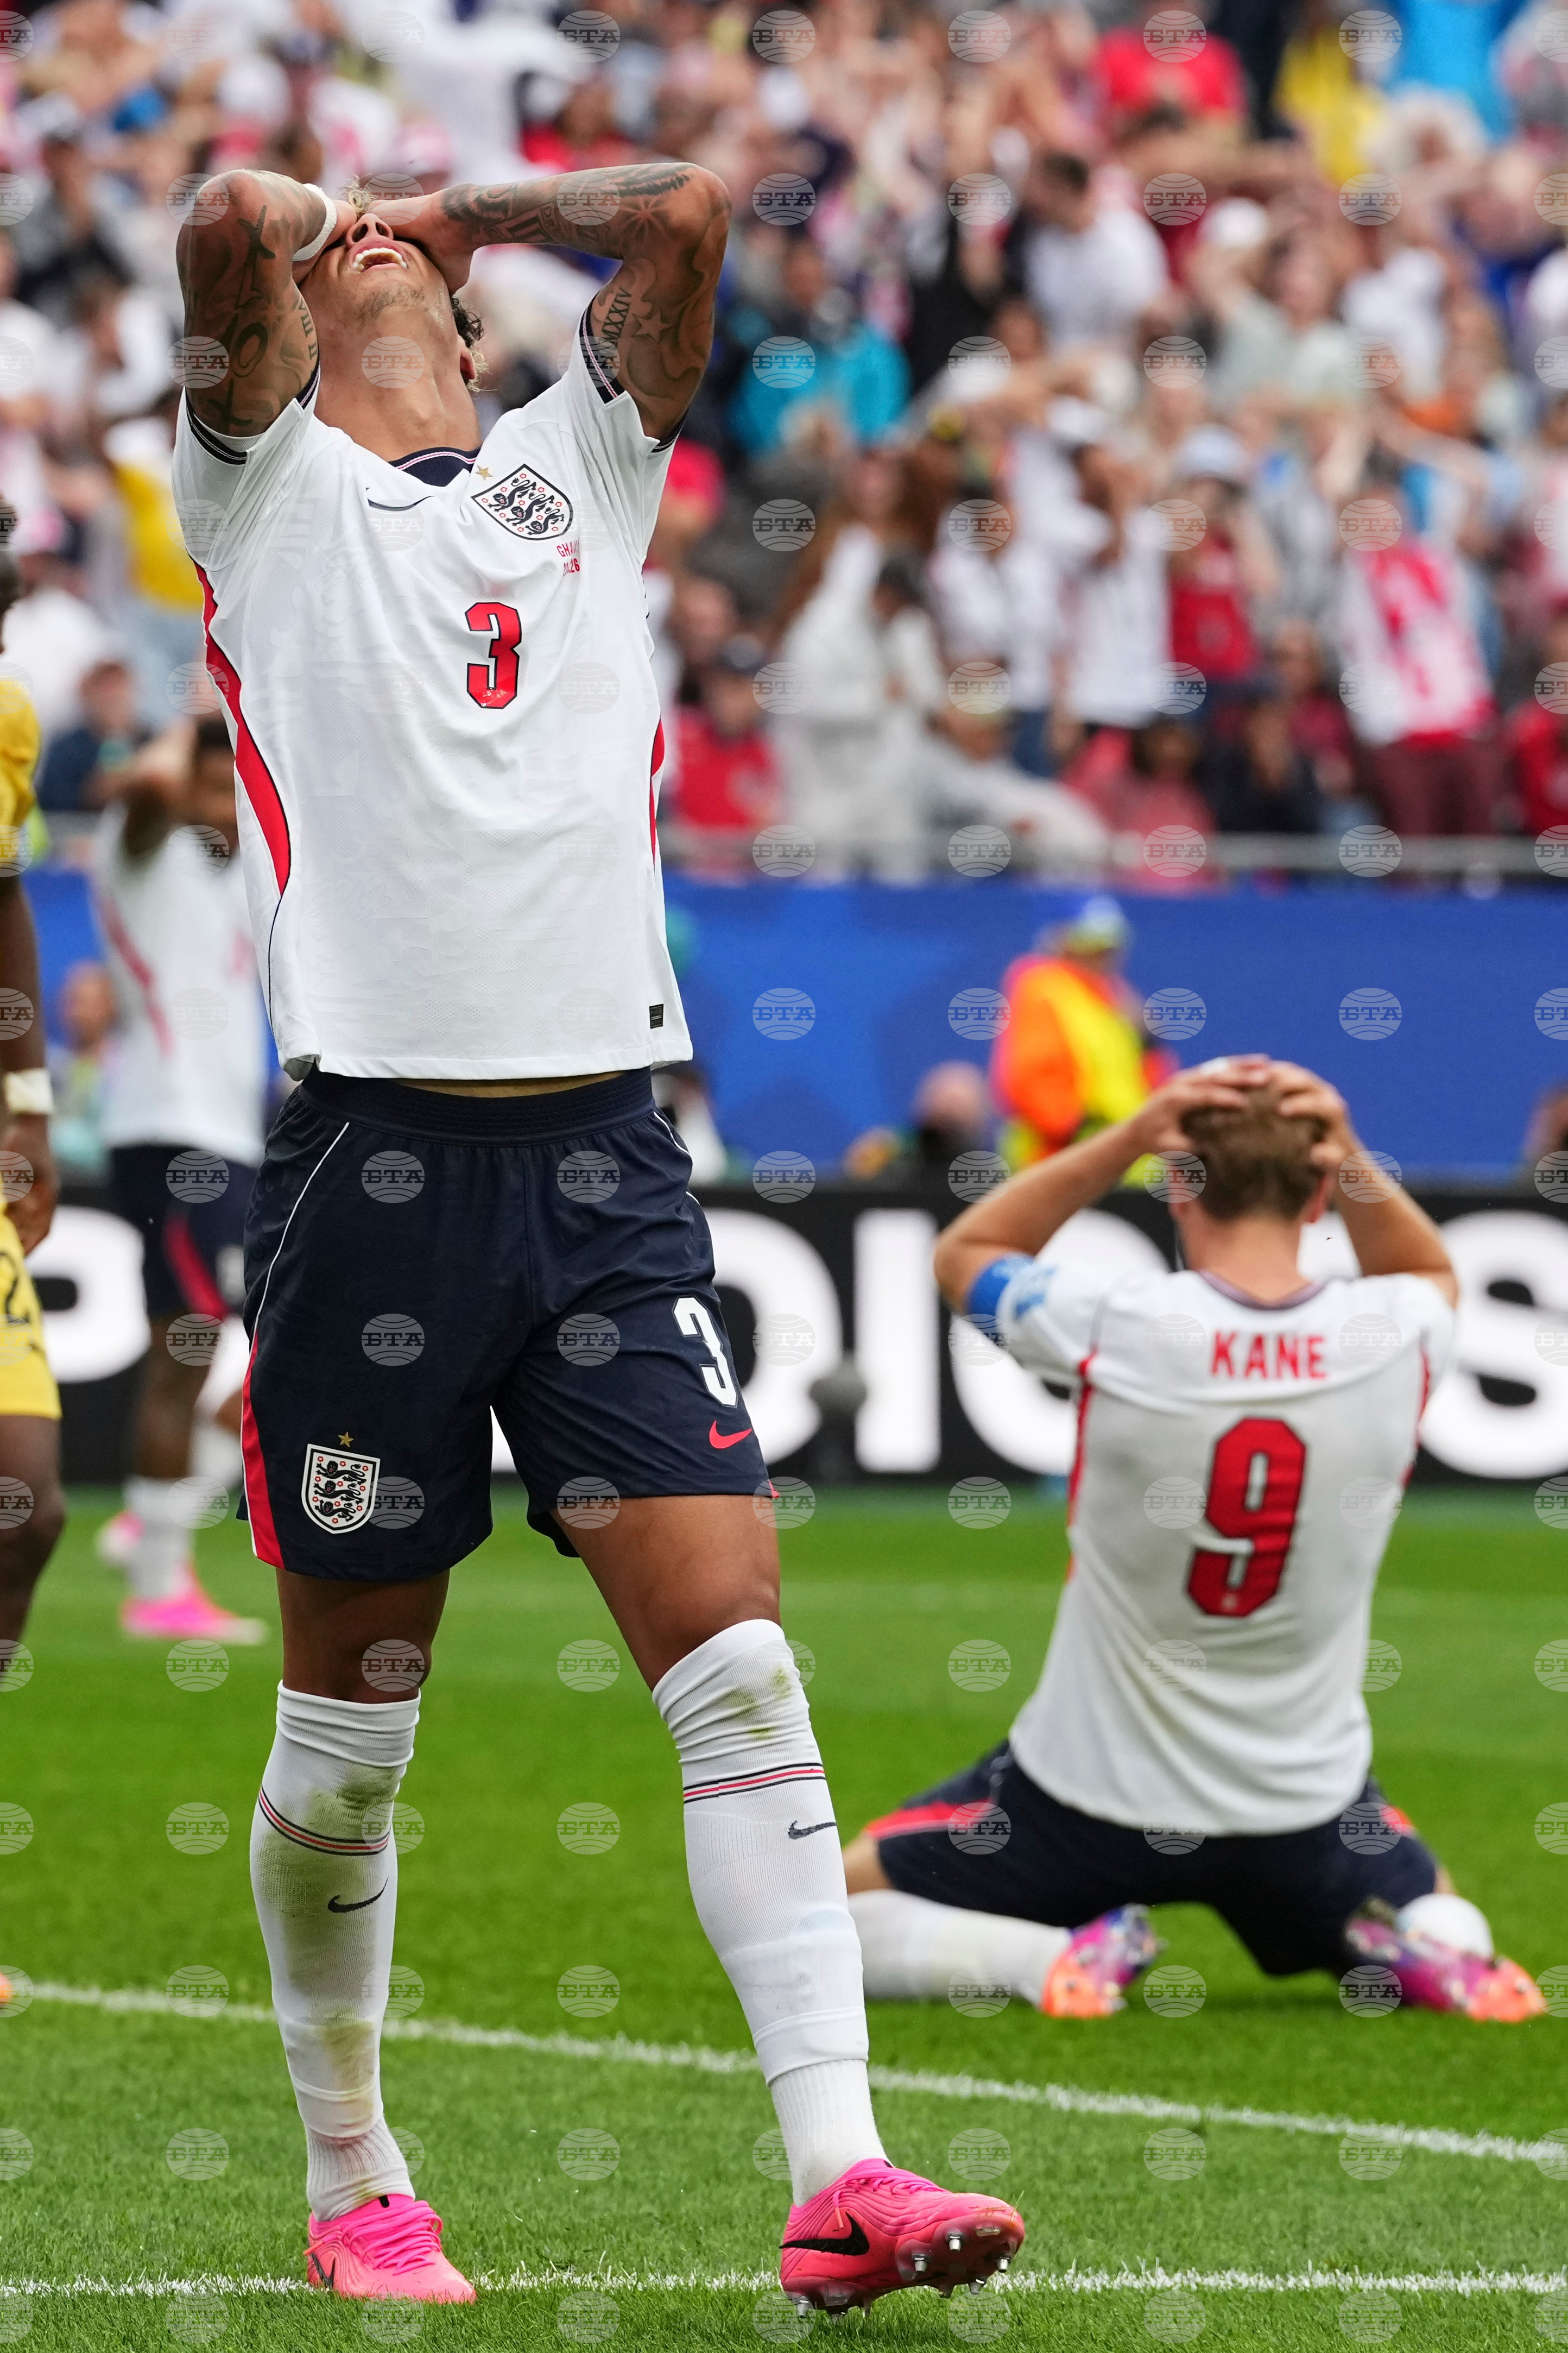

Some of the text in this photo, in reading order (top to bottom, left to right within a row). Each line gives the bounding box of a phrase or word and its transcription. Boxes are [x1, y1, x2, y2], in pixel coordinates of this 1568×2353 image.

[465, 602, 522, 709] 3
[672, 1295, 741, 1409] 3
[1210, 1330, 1328, 1381] KANE
[1184, 1417, 1307, 1619] 9
